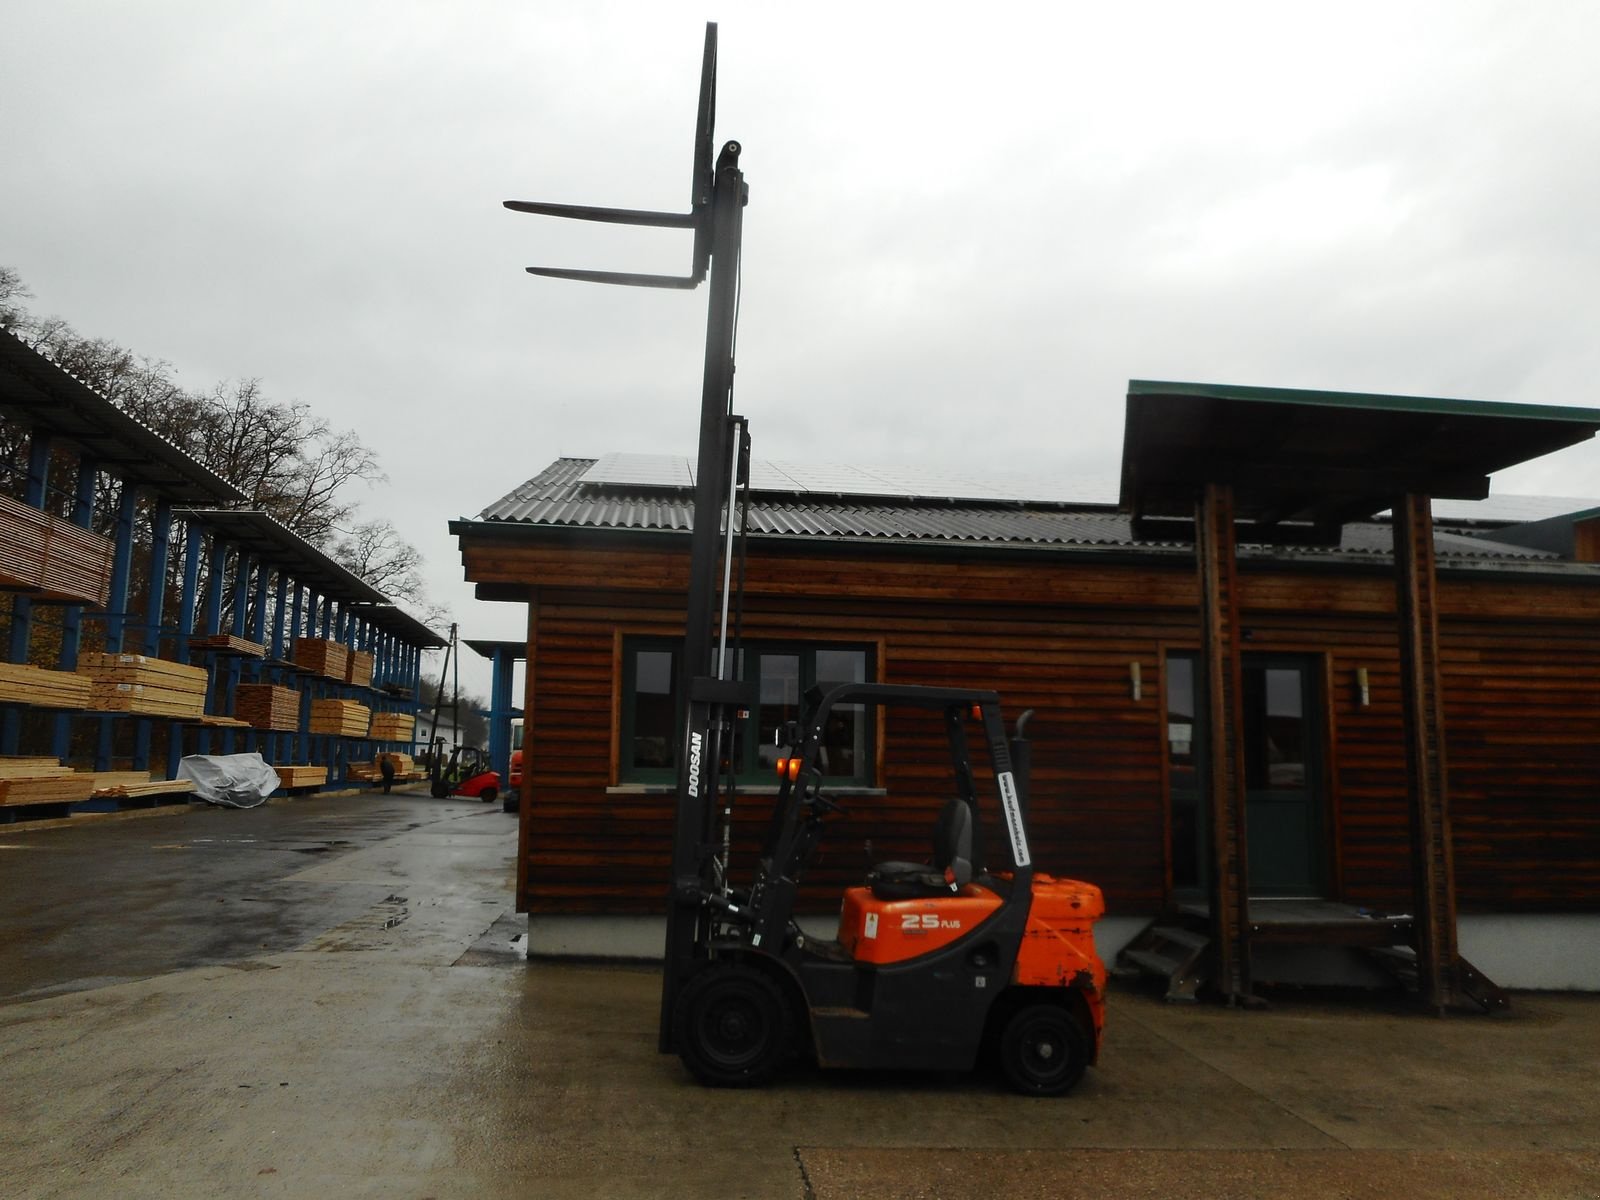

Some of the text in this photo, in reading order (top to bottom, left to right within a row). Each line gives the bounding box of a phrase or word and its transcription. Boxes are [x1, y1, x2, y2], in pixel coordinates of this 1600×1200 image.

[688, 732, 702, 798] DOOSAN
[901, 914, 961, 929] 25 PLUS
